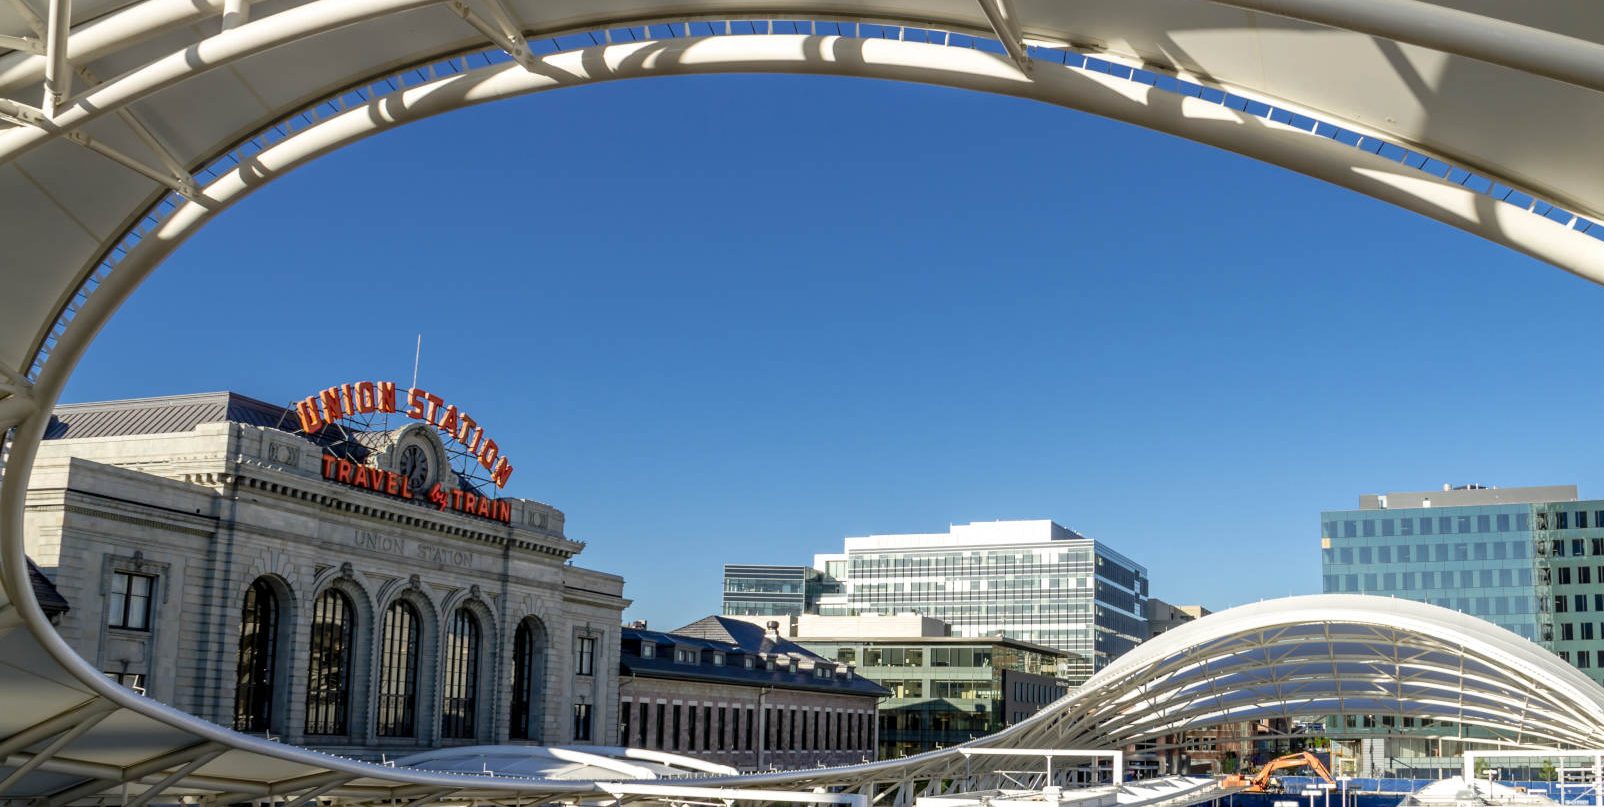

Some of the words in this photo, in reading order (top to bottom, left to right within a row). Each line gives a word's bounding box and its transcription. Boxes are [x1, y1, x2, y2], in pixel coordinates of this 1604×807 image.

[296, 381, 396, 434] UNION
[407, 388, 513, 489] STATION
[322, 454, 414, 499] TRAVEL
[429, 483, 449, 512] by
[451, 489, 511, 524] TRAIN
[354, 530, 405, 554] UNION
[417, 543, 473, 567] STATION
